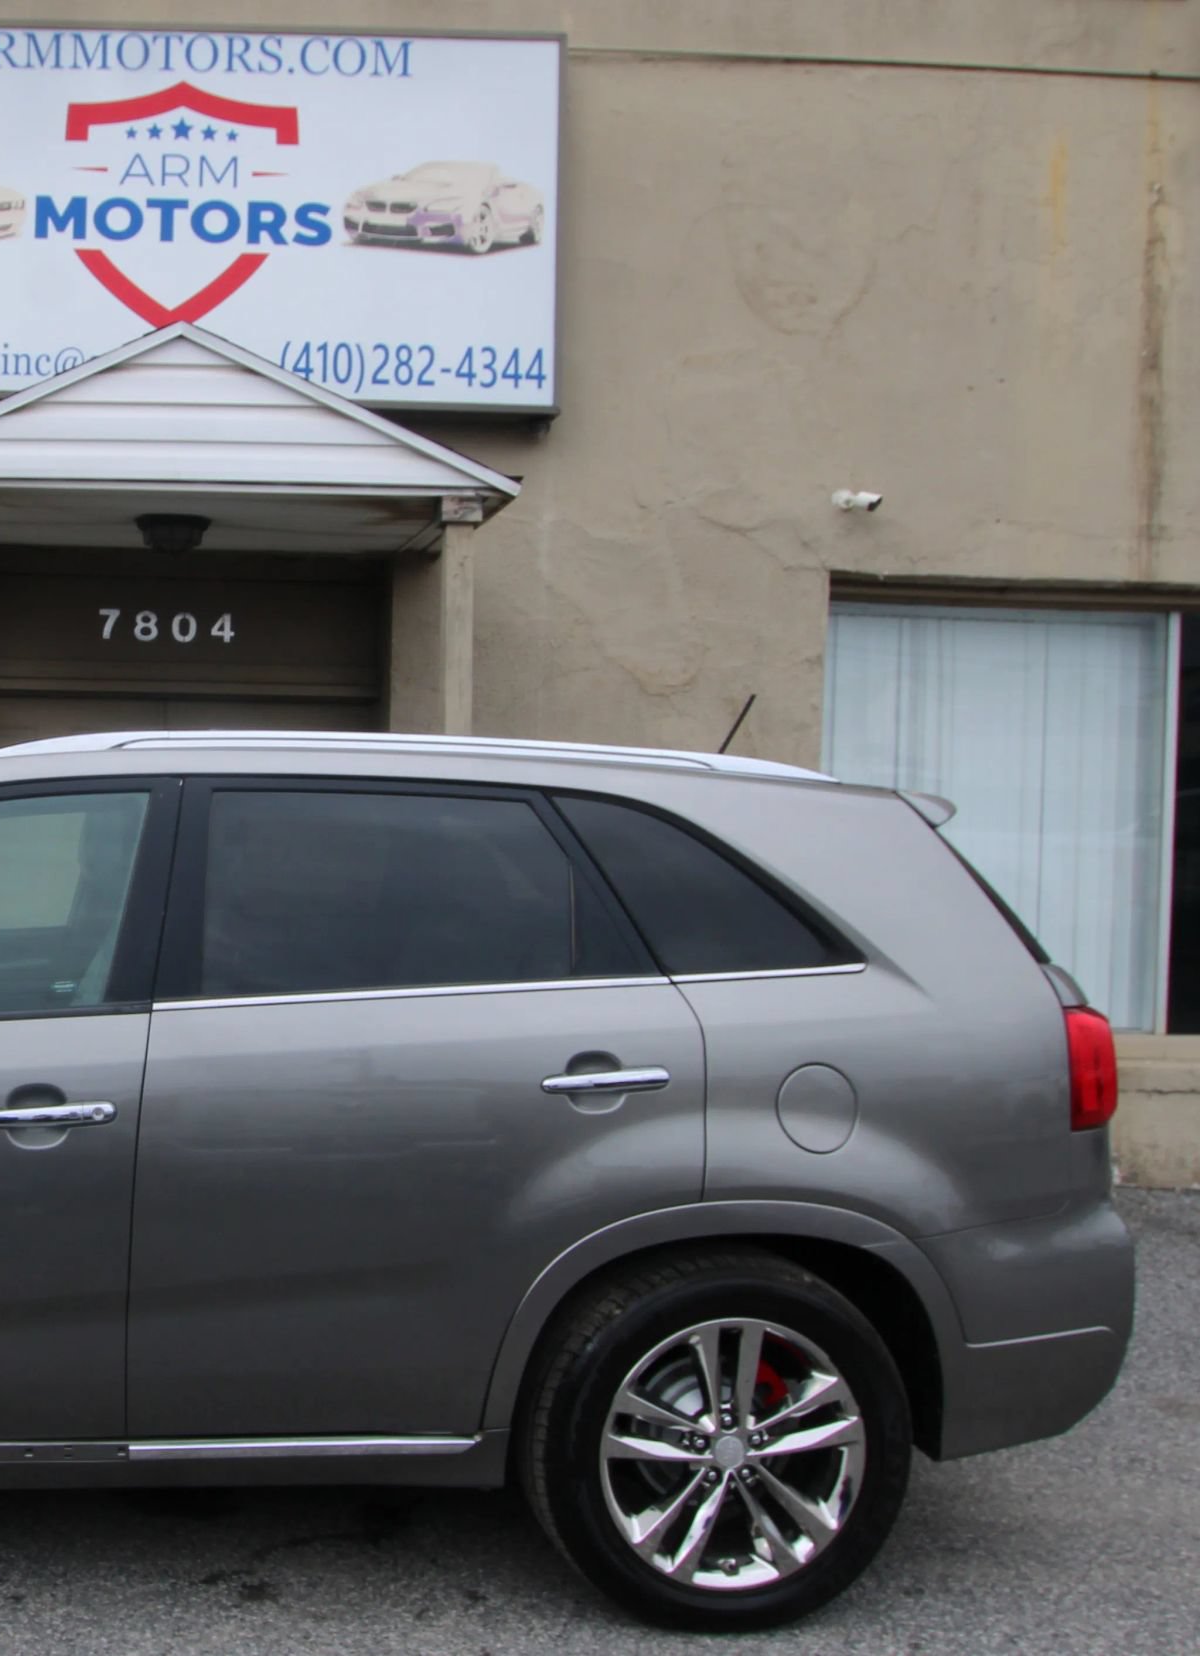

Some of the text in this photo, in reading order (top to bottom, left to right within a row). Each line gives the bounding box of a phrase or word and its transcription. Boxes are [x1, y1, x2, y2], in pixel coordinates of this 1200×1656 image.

[119, 153, 239, 188] ARM
[34, 195, 333, 246] MOTORS
[99, 608, 235, 643] 7804
